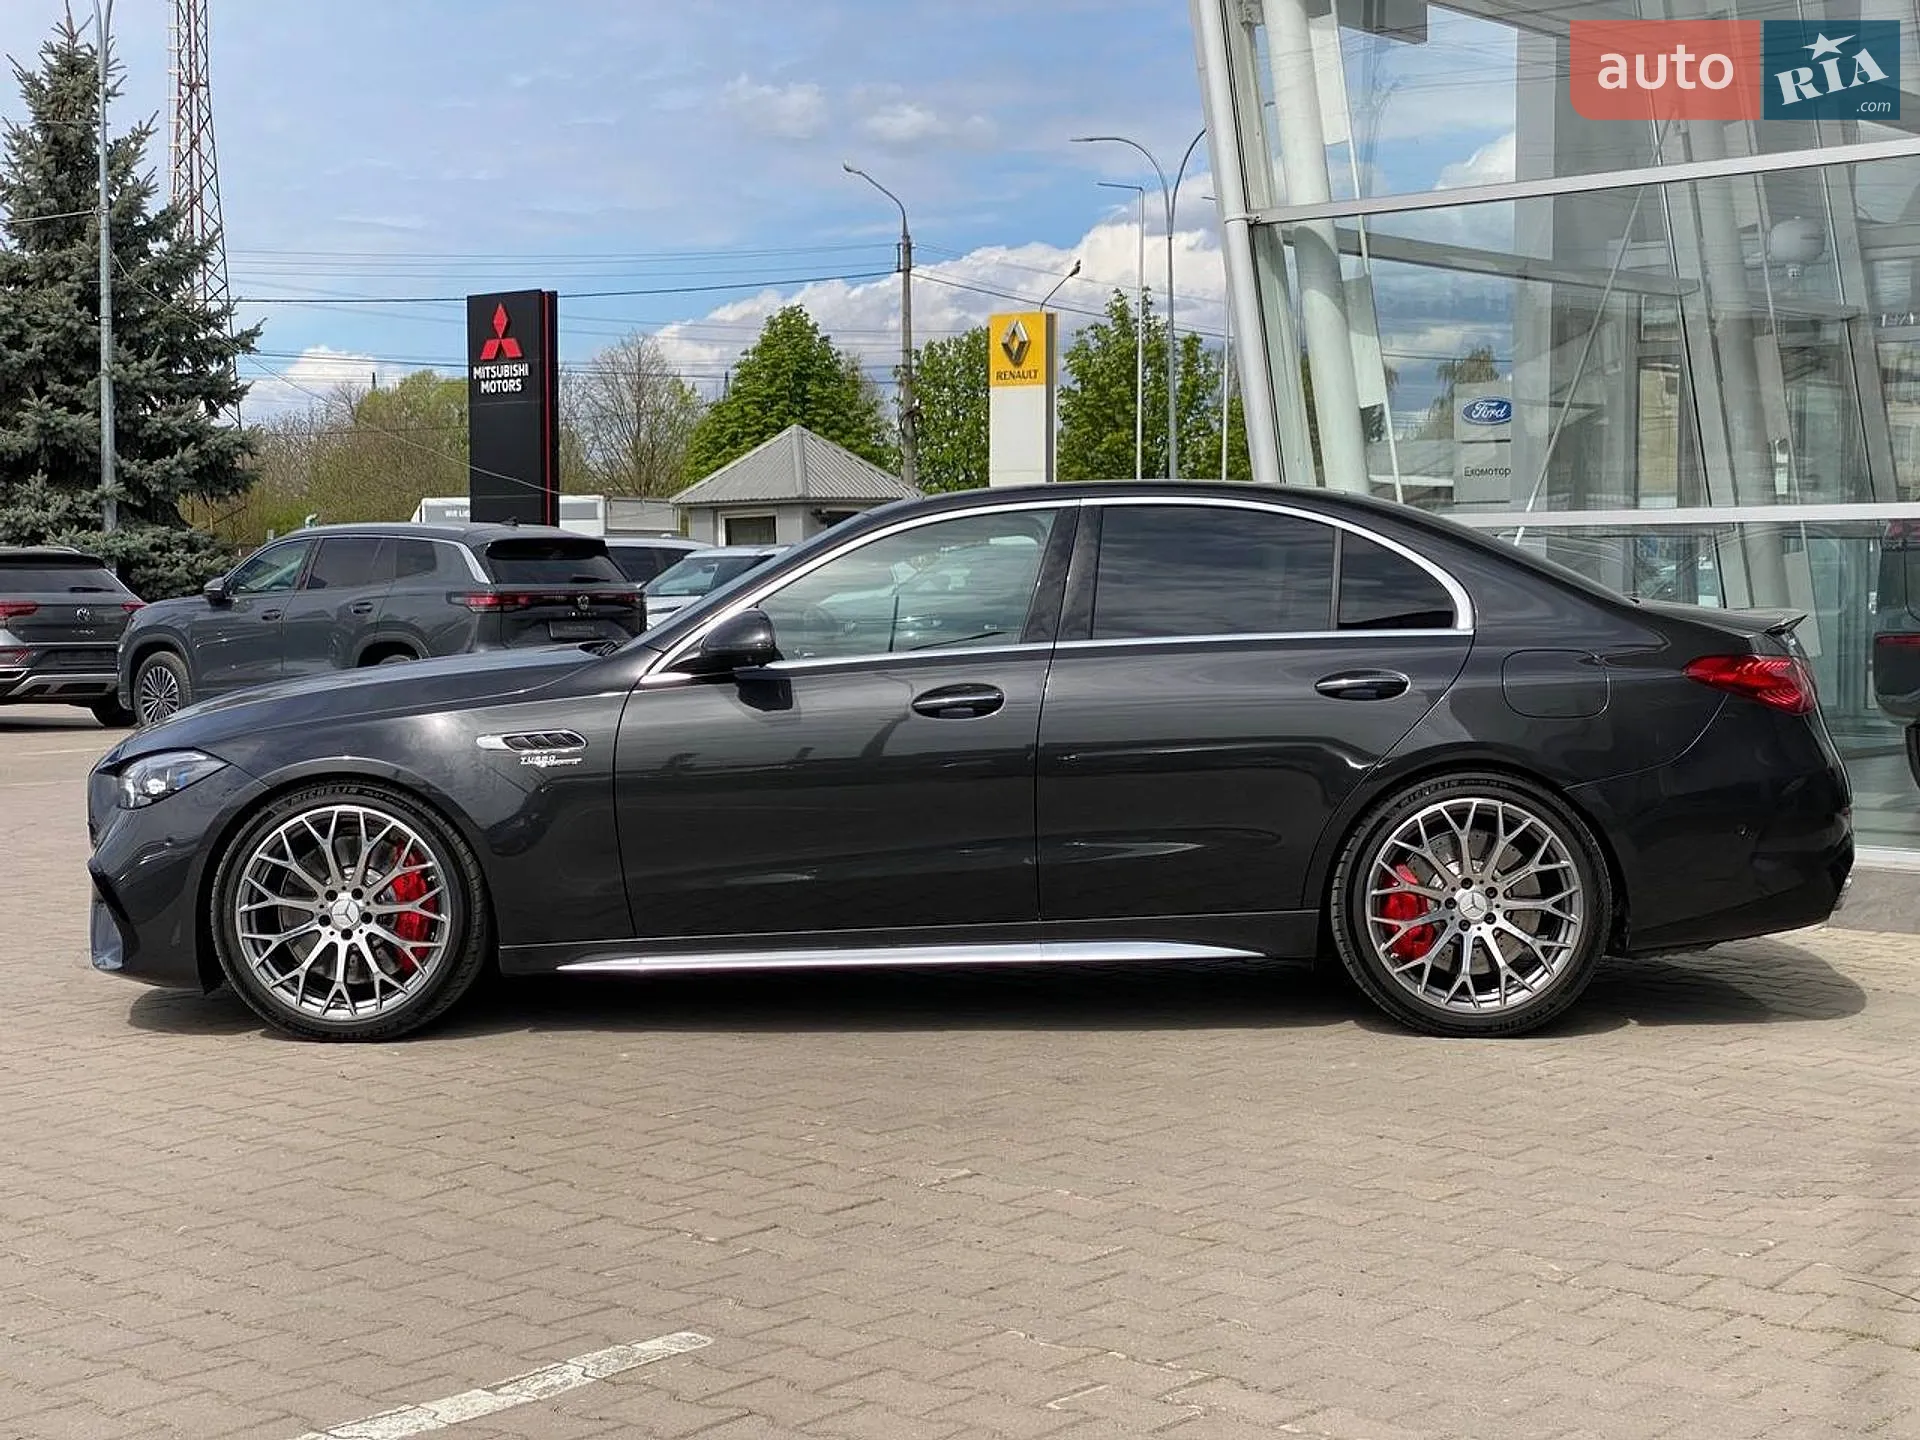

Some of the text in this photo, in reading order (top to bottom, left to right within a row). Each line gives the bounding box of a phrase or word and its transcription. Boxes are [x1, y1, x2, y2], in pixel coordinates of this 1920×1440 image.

[473, 363, 529, 380] MITSUBISHI
[996, 369, 1039, 381] RENAULT
[481, 379, 522, 394] MOTORS
[1471, 402, 1507, 419] Ford
